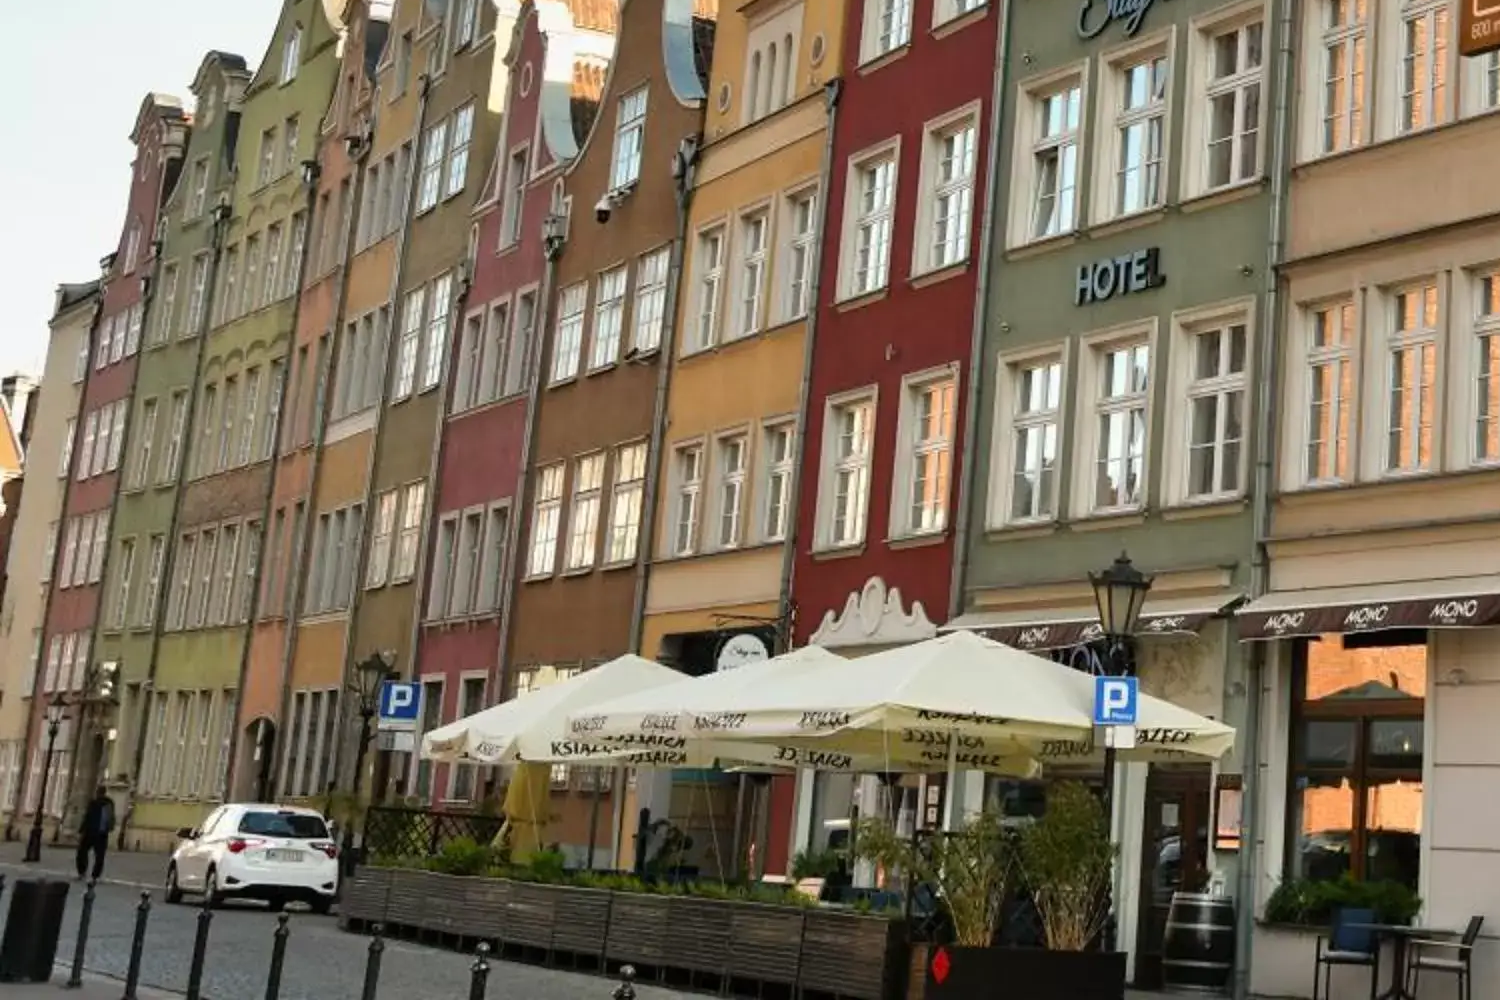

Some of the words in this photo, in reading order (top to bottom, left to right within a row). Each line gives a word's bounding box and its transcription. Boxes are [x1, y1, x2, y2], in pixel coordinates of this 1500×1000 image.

[1075, 246, 1166, 307] HOTEL
[1344, 606, 1389, 625] MONO
[1429, 600, 1478, 619] MONO
[1263, 612, 1305, 630] MONO
[1017, 626, 1050, 644] MONO
[387, 684, 413, 715] P
[1103, 681, 1129, 719] P
